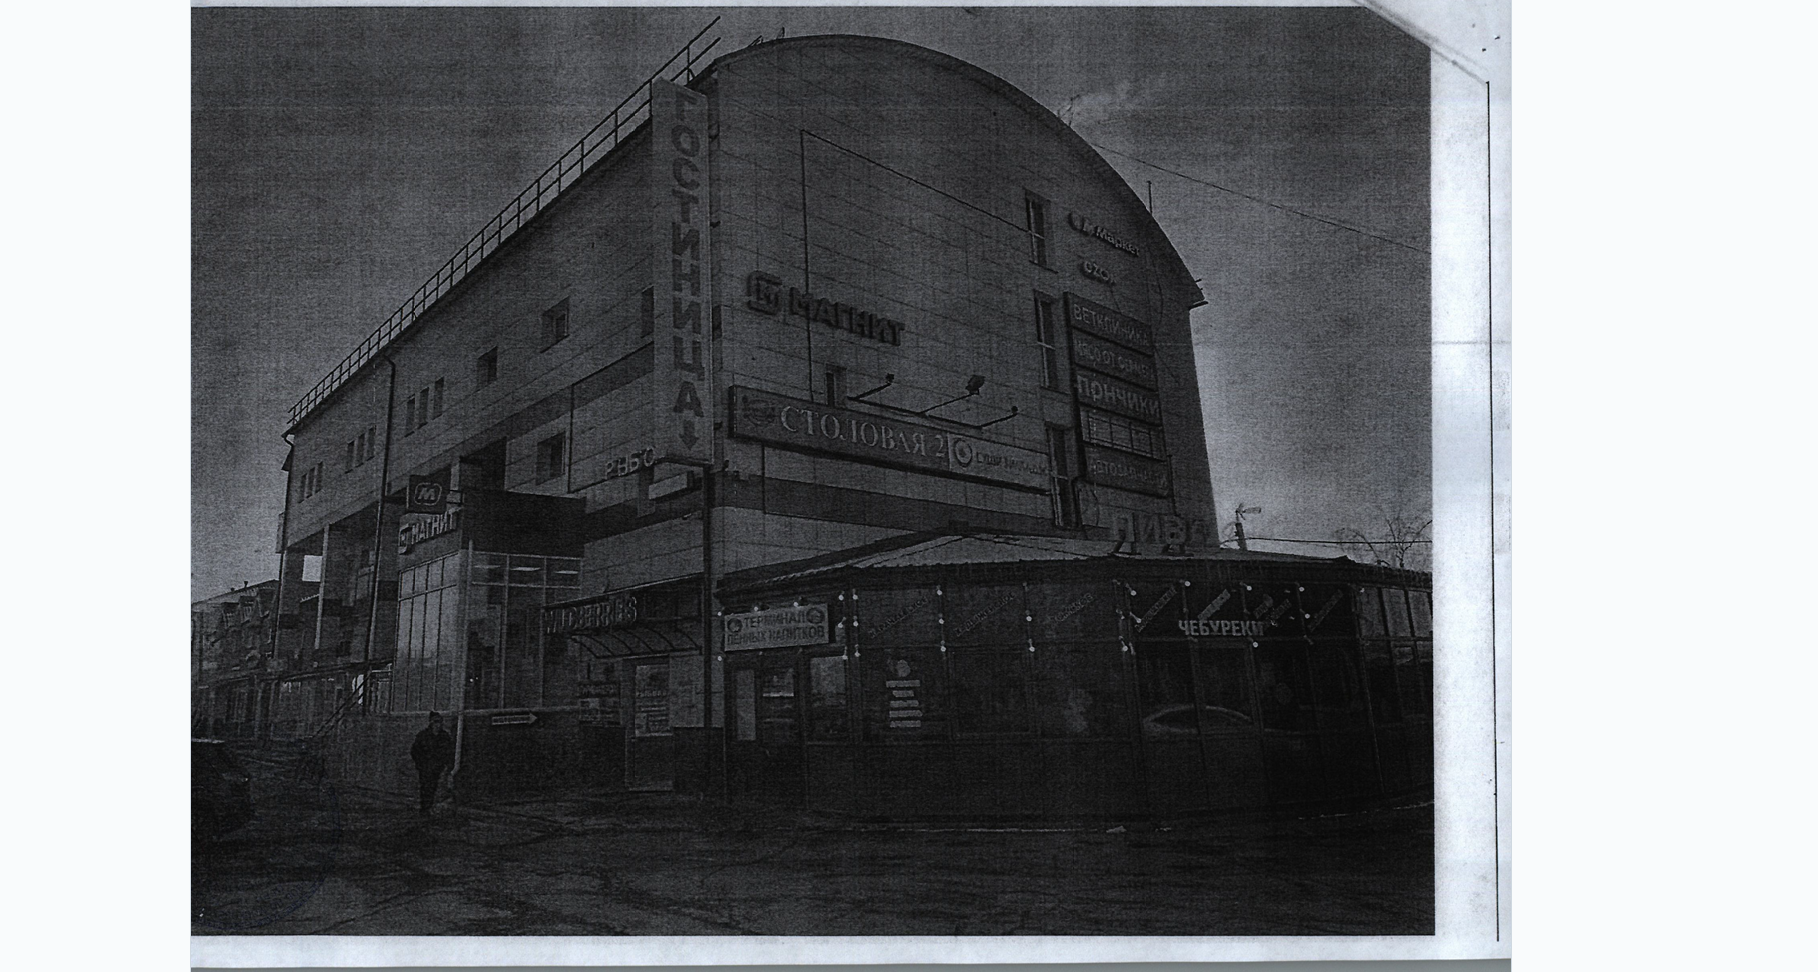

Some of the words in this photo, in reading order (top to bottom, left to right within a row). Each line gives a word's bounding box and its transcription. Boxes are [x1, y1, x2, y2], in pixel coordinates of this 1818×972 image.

[671, 89, 705, 418] ГОСТИНИЦА
[790, 286, 905, 347] МАГНИТ
[1075, 373, 1161, 420] ПОНЧИКИ
[781, 404, 926, 457] СТОЛОВАЯ
[935, 433, 947, 459] 2
[411, 508, 459, 546] МАГНИТ
[727, 629, 767, 646] ПЕННЫХ
[769, 624, 825, 644] НАПИТКОВ
[743, 609, 806, 630] ТЕРМИНАЛ
[1178, 619, 1264, 637] ЧЕБУРЕКИ
